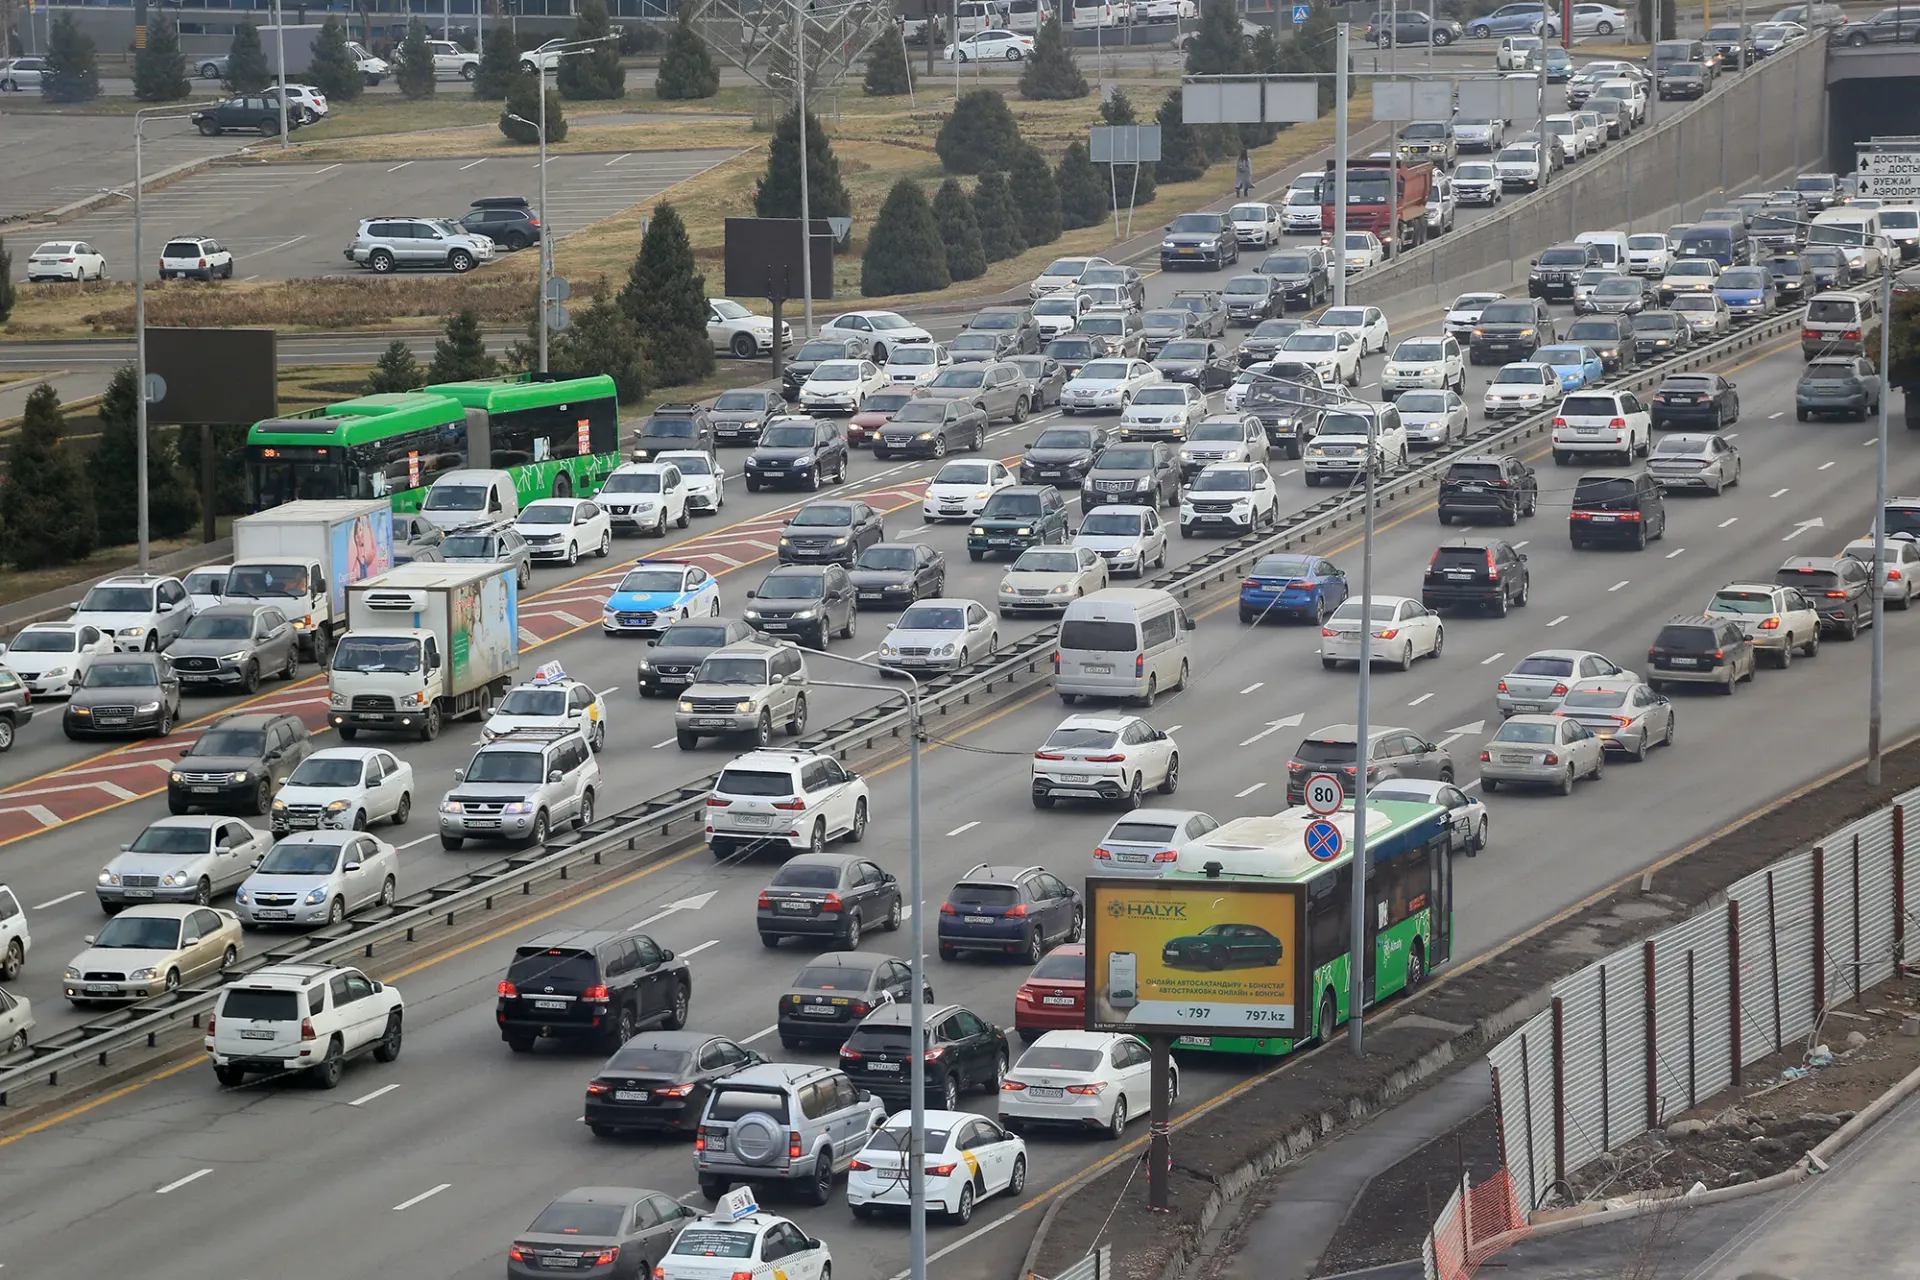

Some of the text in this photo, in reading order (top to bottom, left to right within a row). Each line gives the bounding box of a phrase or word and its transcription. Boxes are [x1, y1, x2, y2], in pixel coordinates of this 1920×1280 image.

[1314, 787, 1333, 802] 80
[1128, 904, 1187, 917] HALYK
[1189, 1008, 1210, 1018] 797
[1246, 1011, 1285, 1021] 797.kz
